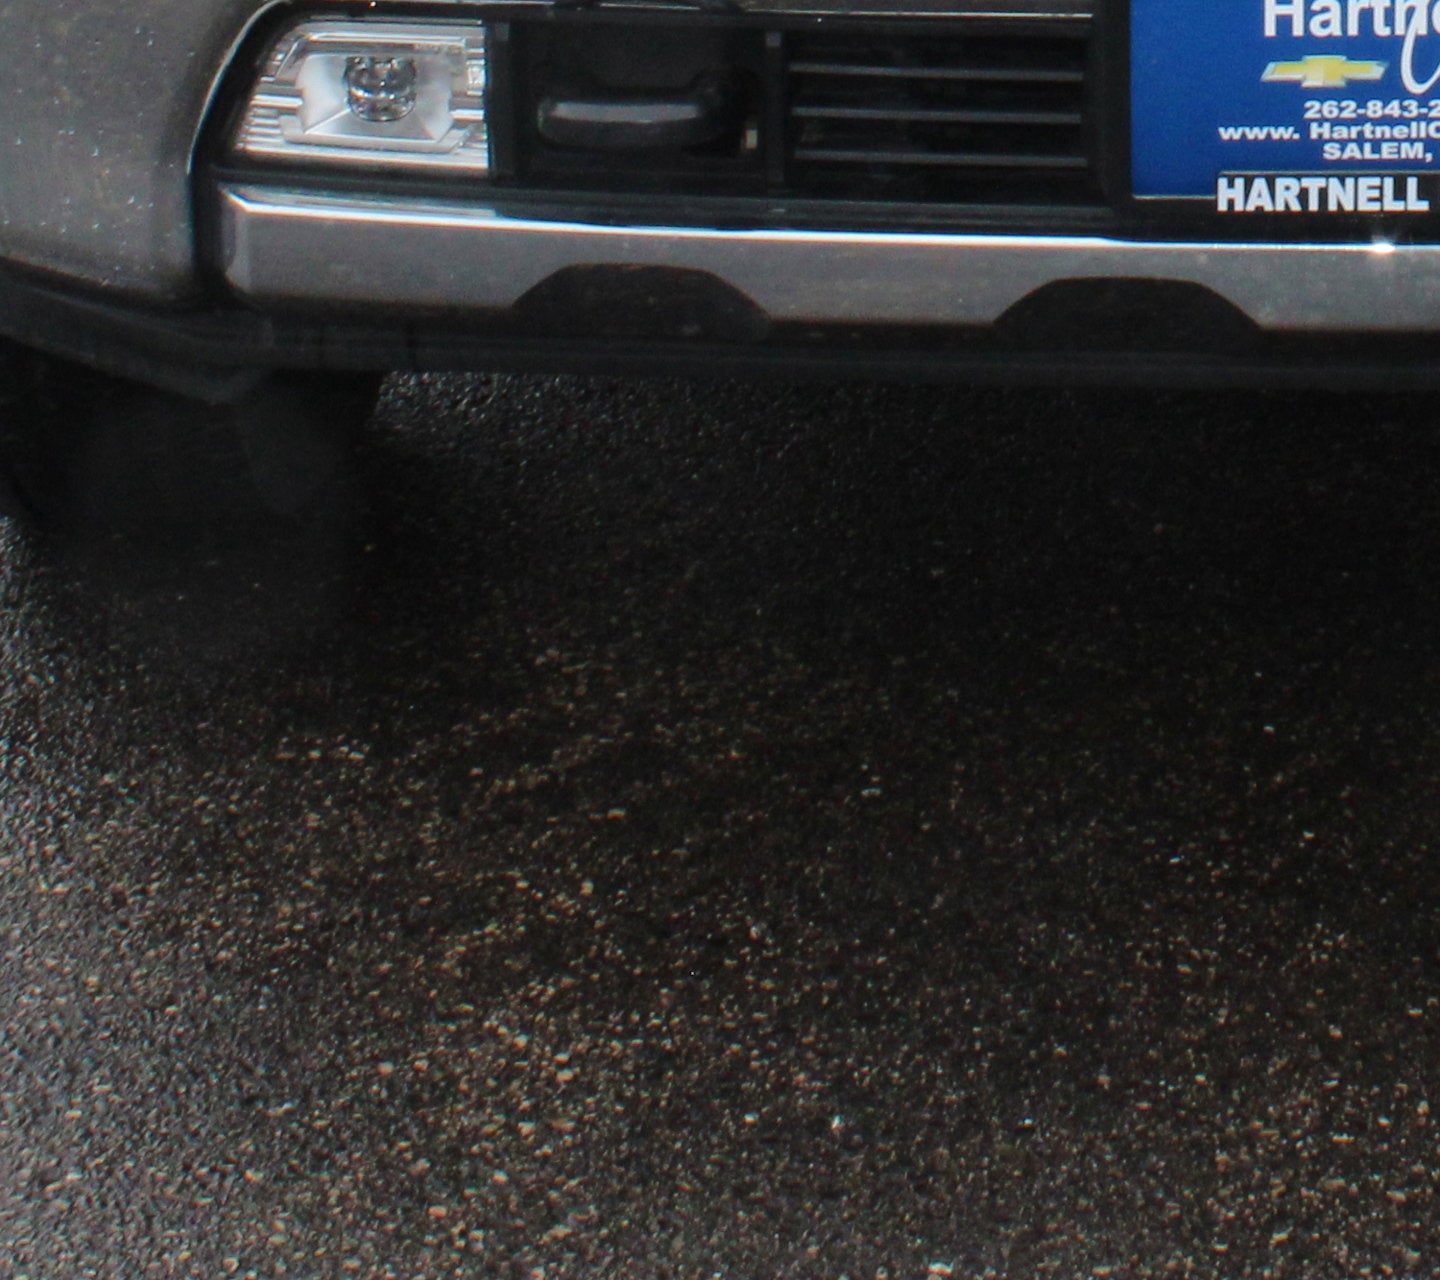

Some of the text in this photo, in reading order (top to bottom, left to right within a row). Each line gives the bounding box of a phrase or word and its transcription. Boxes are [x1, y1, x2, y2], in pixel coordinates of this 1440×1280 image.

[1218, 125, 1301, 141] www.
[1322, 141, 1434, 163] SALEM,
[1216, 176, 1430, 212] HARTNELL
